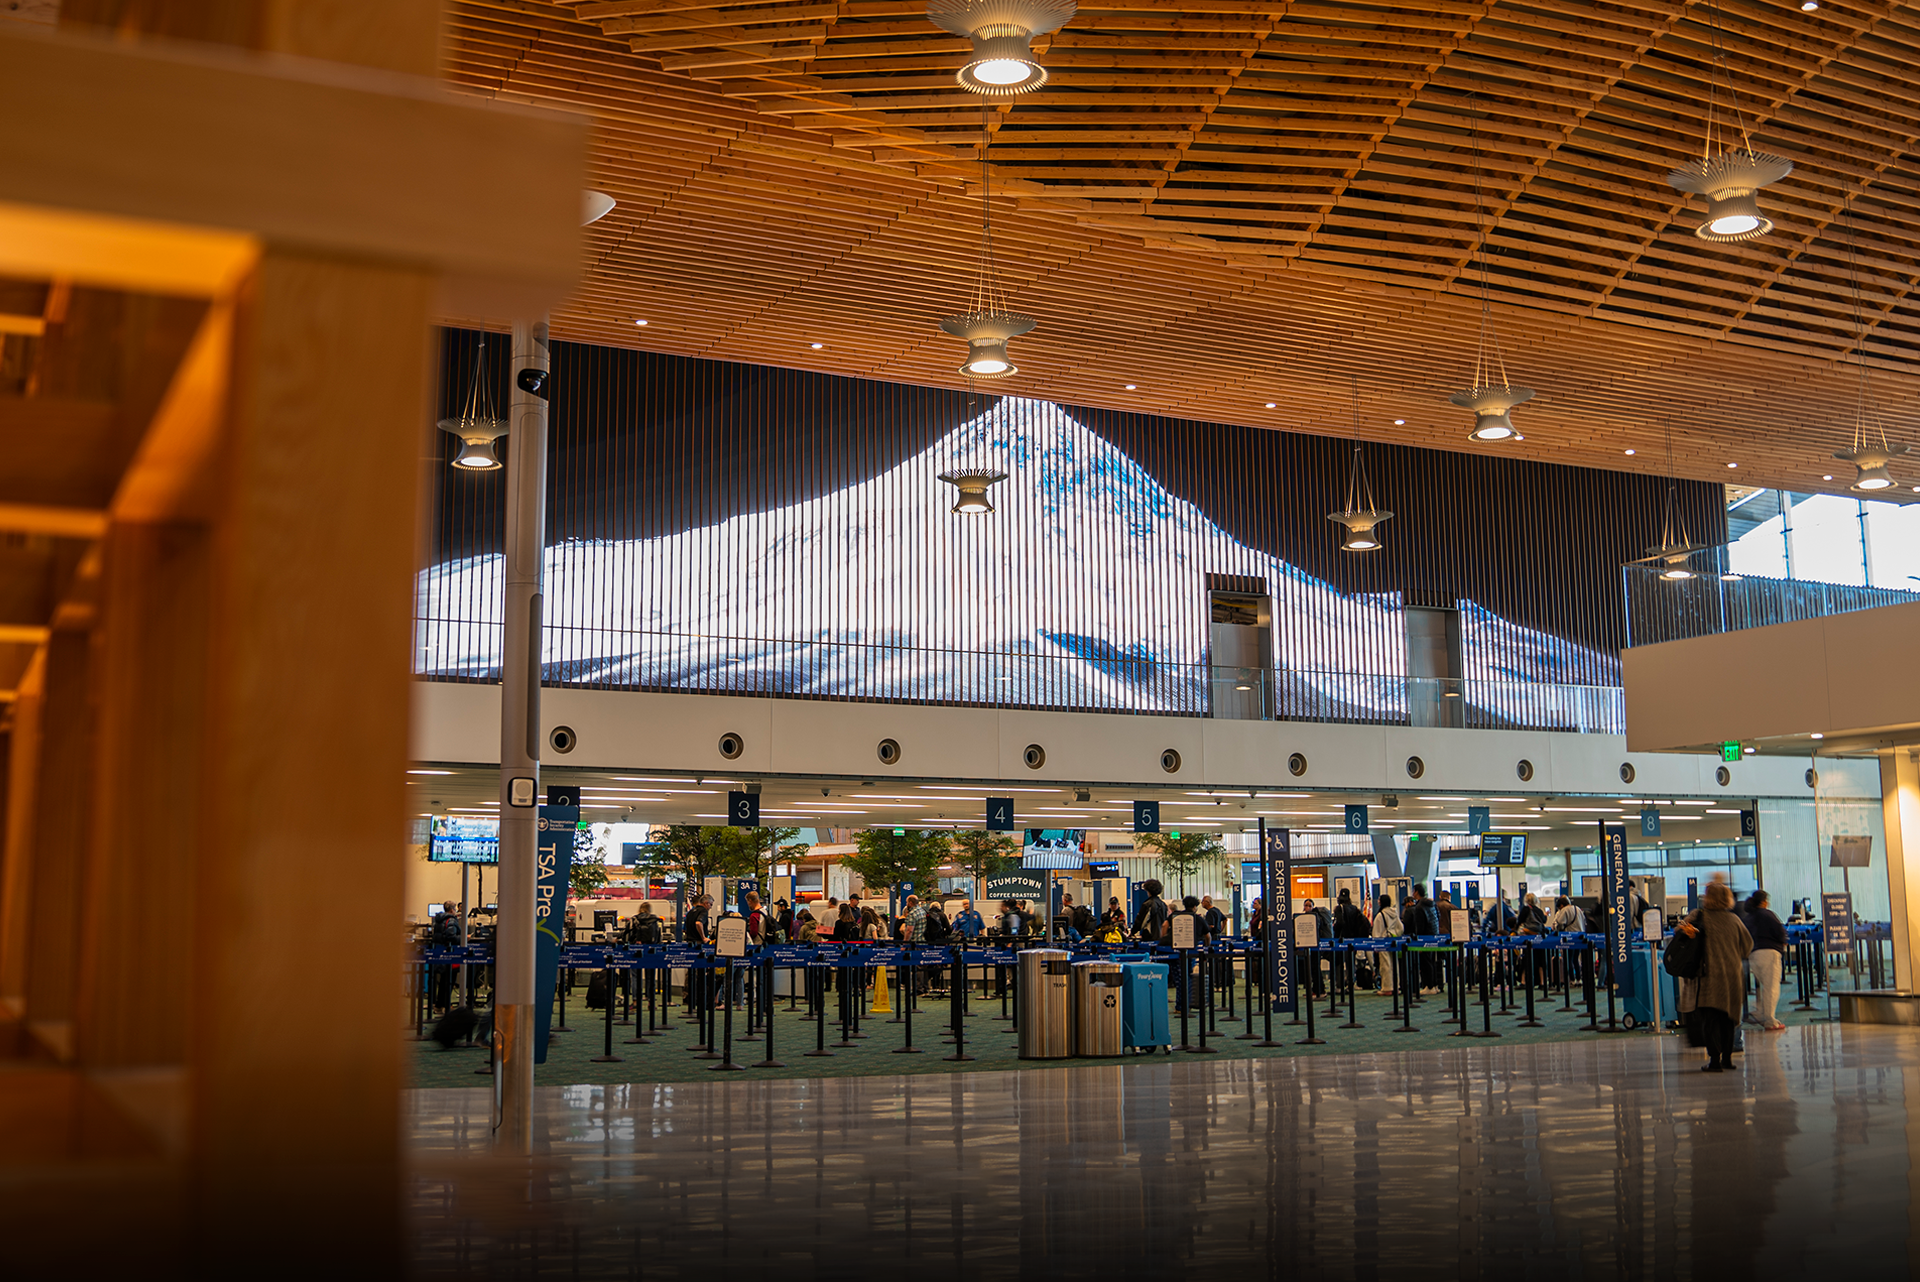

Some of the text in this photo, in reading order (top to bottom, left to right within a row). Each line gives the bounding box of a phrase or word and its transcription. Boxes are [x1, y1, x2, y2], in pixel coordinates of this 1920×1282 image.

[1724, 746, 1739, 761] EXIT
[738, 800, 750, 819] 3
[994, 806, 1006, 824] 4
[1141, 808, 1152, 826] 5
[1352, 812, 1362, 828] 6
[1475, 814, 1483, 829] 7
[1647, 816, 1655, 831] 8
[1746, 816, 1754, 831] 9
[536, 843, 556, 917] TSA Pre
[987, 877, 1042, 889] STUMPTOWN
[1613, 833, 1627, 963] GENERAL BOARDING
[1274, 860, 1289, 1003] EXPRESS, EMPLOYEE
